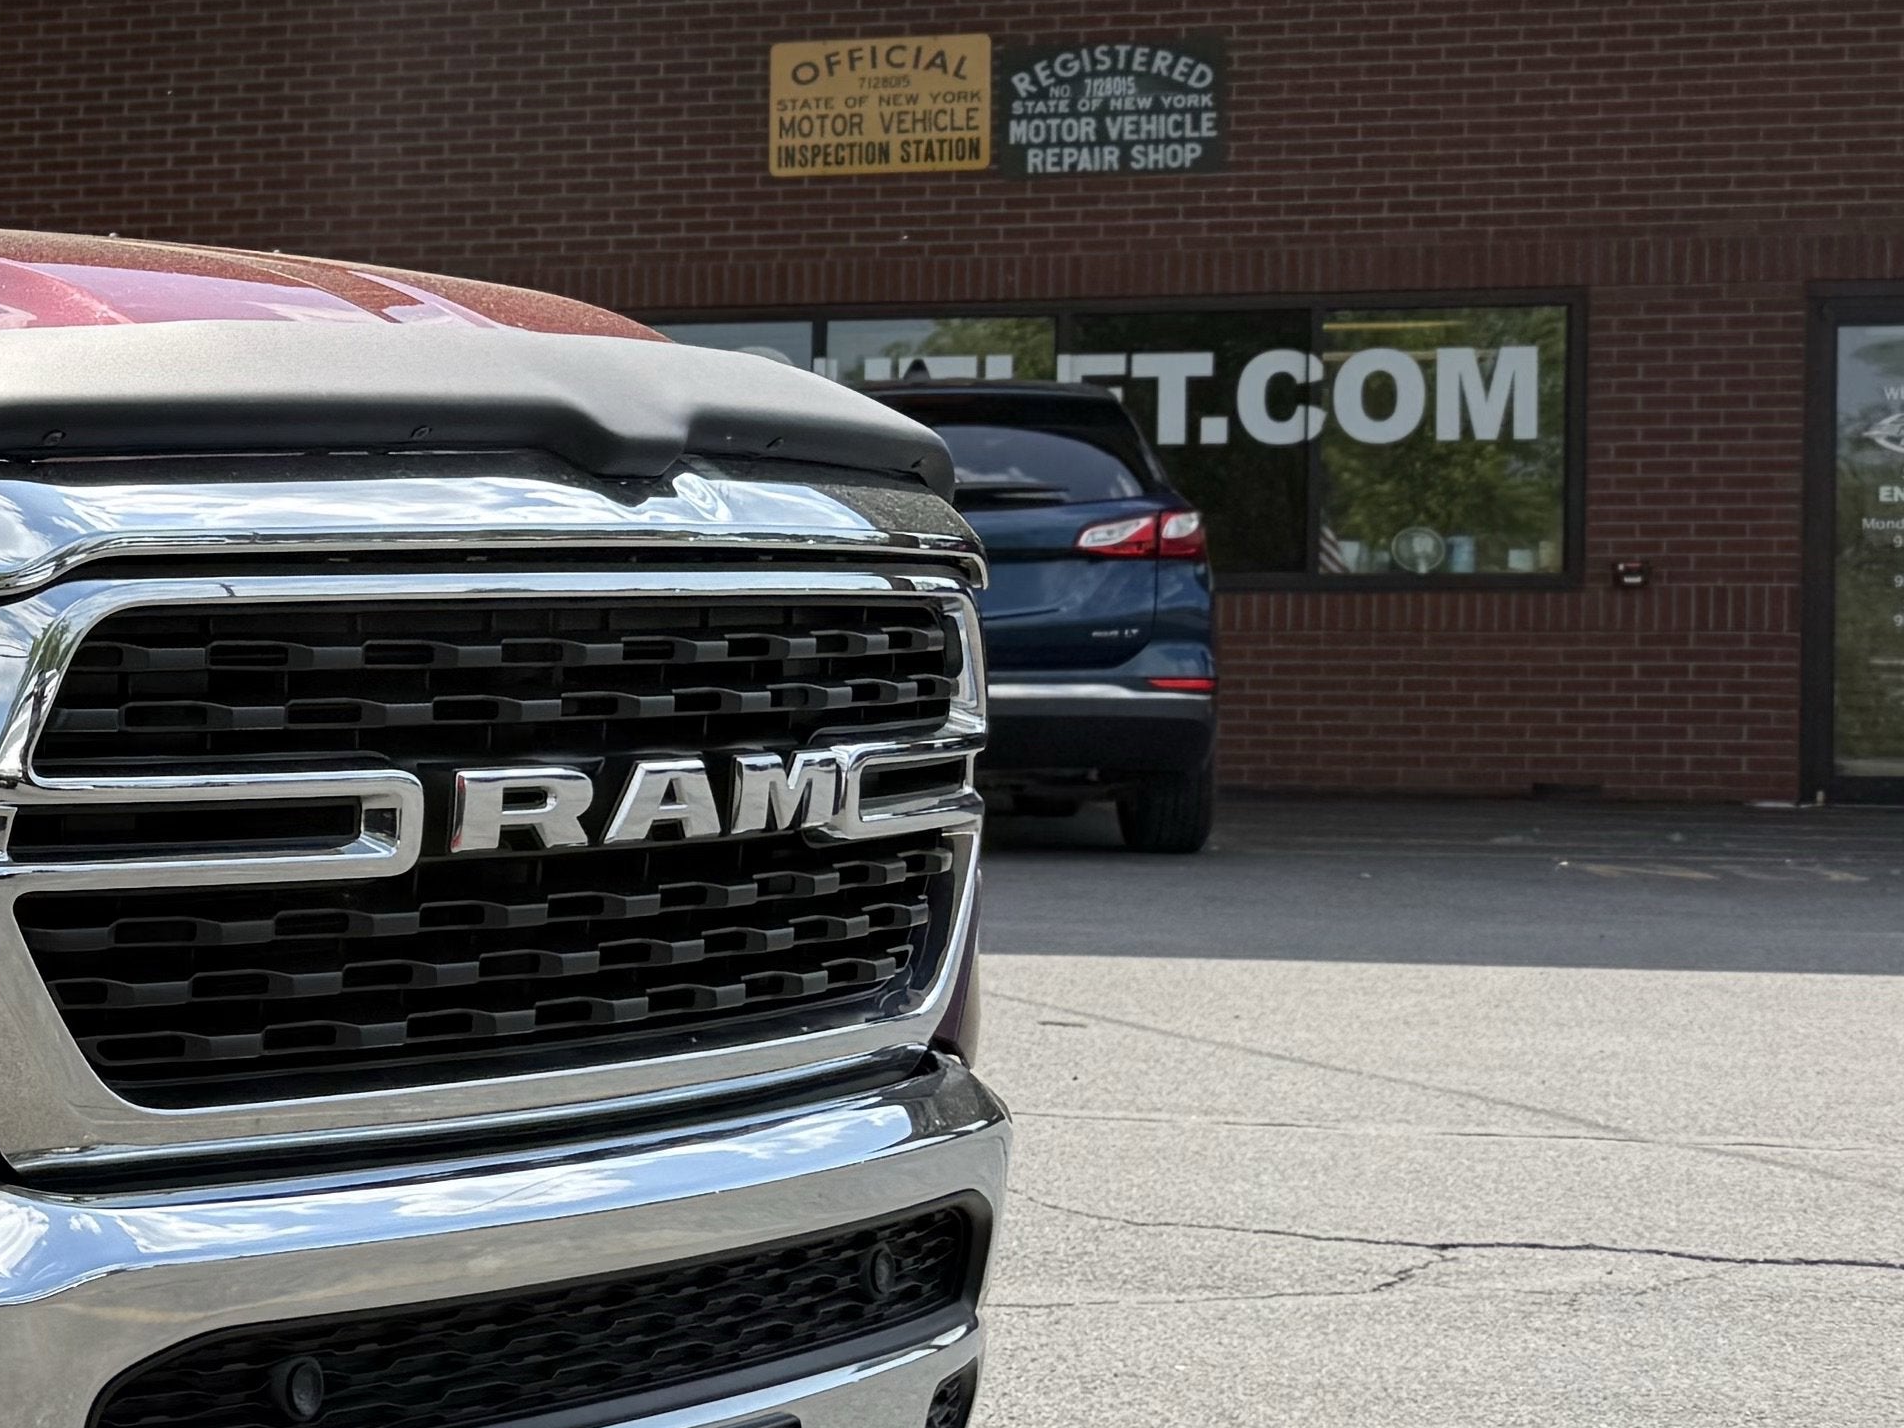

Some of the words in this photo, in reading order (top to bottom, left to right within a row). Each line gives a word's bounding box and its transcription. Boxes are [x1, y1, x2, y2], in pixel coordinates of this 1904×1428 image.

[791, 44, 968, 86] OFFICIAL
[1010, 44, 1214, 98] REGISTERED
[776, 96, 835, 112] STATE
[844, 95, 870, 109] OF
[878, 92, 920, 107] NEW
[929, 90, 982, 104] YORK
[1011, 99, 1070, 115] STATE
[1077, 97, 1103, 112] OF
[1109, 95, 1153, 111] NEW
[1160, 93, 1214, 109] YORK
[1049, 83, 1071, 98] NO
[778, 112, 864, 139] MOTOR
[879, 107, 980, 135] VEHICLE
[1008, 116, 1097, 145] MOTOR
[1105, 111, 1218, 141] VEHICLE
[777, 140, 891, 169] INSPECTION
[900, 136, 981, 164] STATION
[1027, 144, 1121, 173] REPAIR
[1130, 141, 1203, 170] SHOP
[450, 749, 840, 854] RAM
